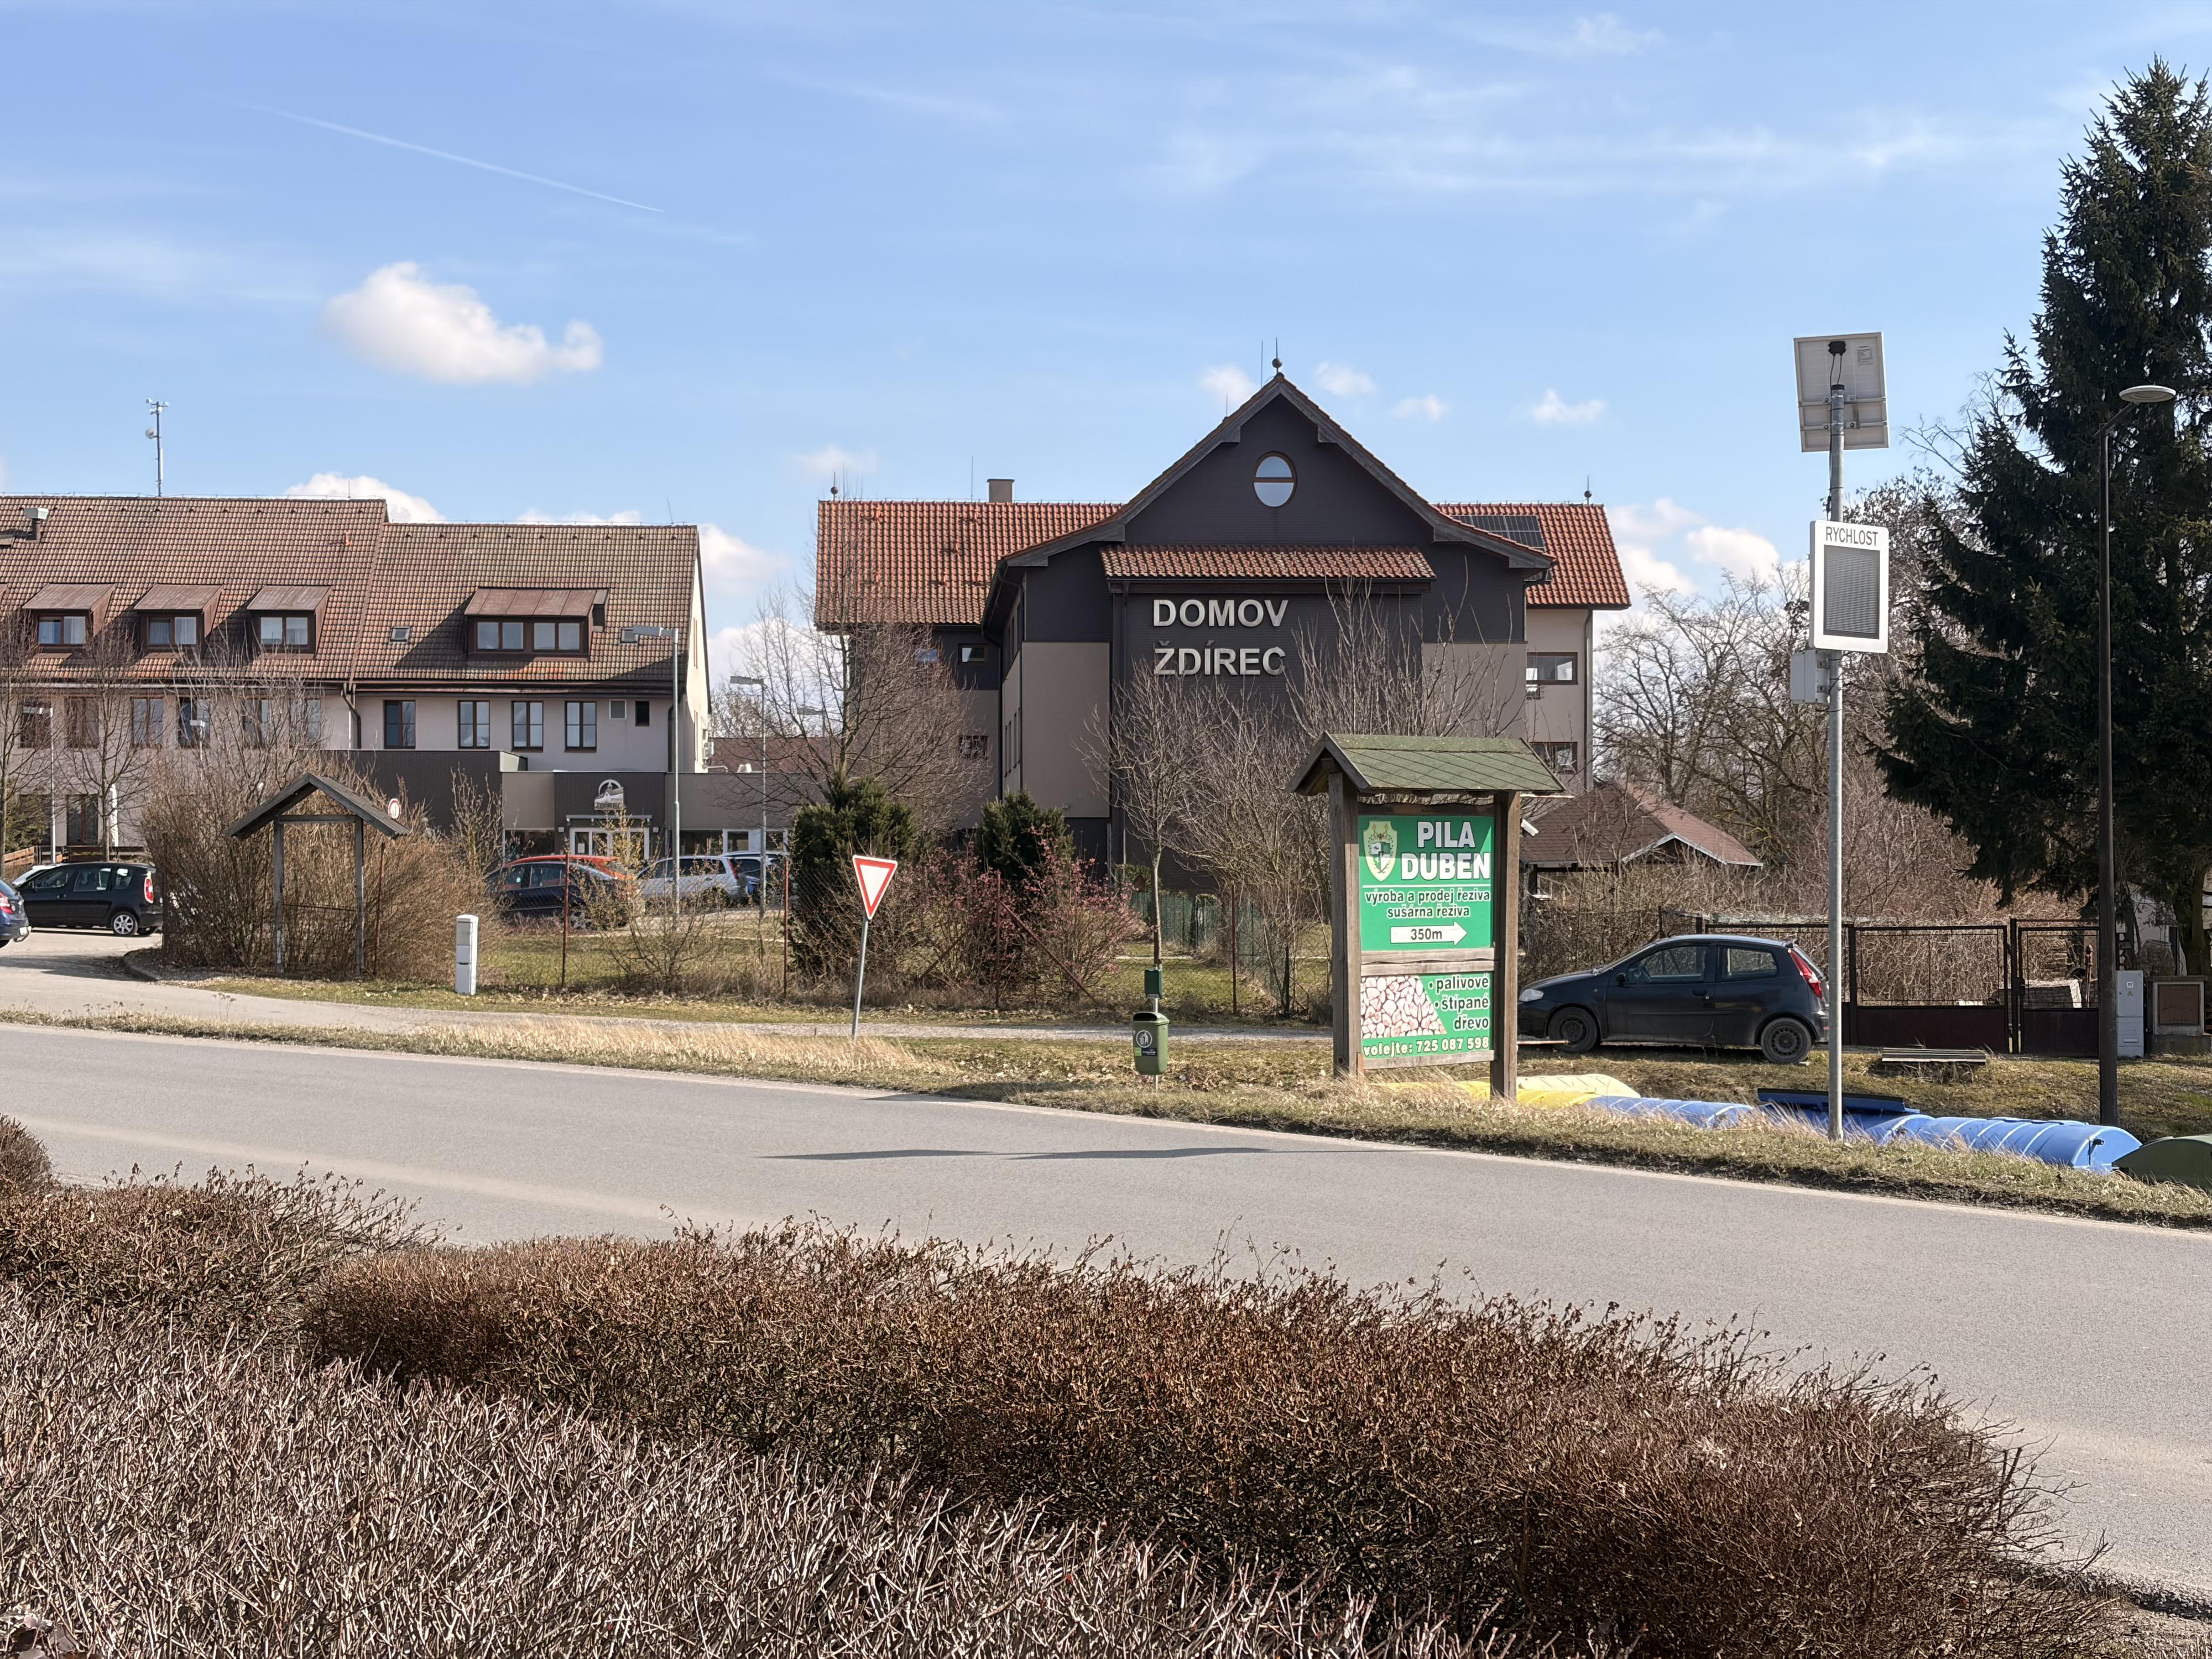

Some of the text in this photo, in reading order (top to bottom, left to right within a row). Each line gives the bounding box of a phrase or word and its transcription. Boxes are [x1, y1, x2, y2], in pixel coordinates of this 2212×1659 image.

[1826, 526, 1878, 546] RYCHLOST
[1153, 599, 1289, 627] DOMOV
[1154, 640, 1286, 676] ŽDÍREC
[1417, 821, 1476, 848] PILA
[1401, 852, 1490, 880] DUBEN
[1365, 888, 1490, 905] výroba a prodej řeziva
[1387, 905, 1469, 918] sušárna řeziva
[1410, 928, 1442, 941] 350m
[1436, 974, 1489, 992] palivové
[1442, 995, 1489, 1011] štípané
[1454, 1016, 1489, 1030] dřevo
[1363, 1036, 1489, 1057] volejte: 725 087 598
